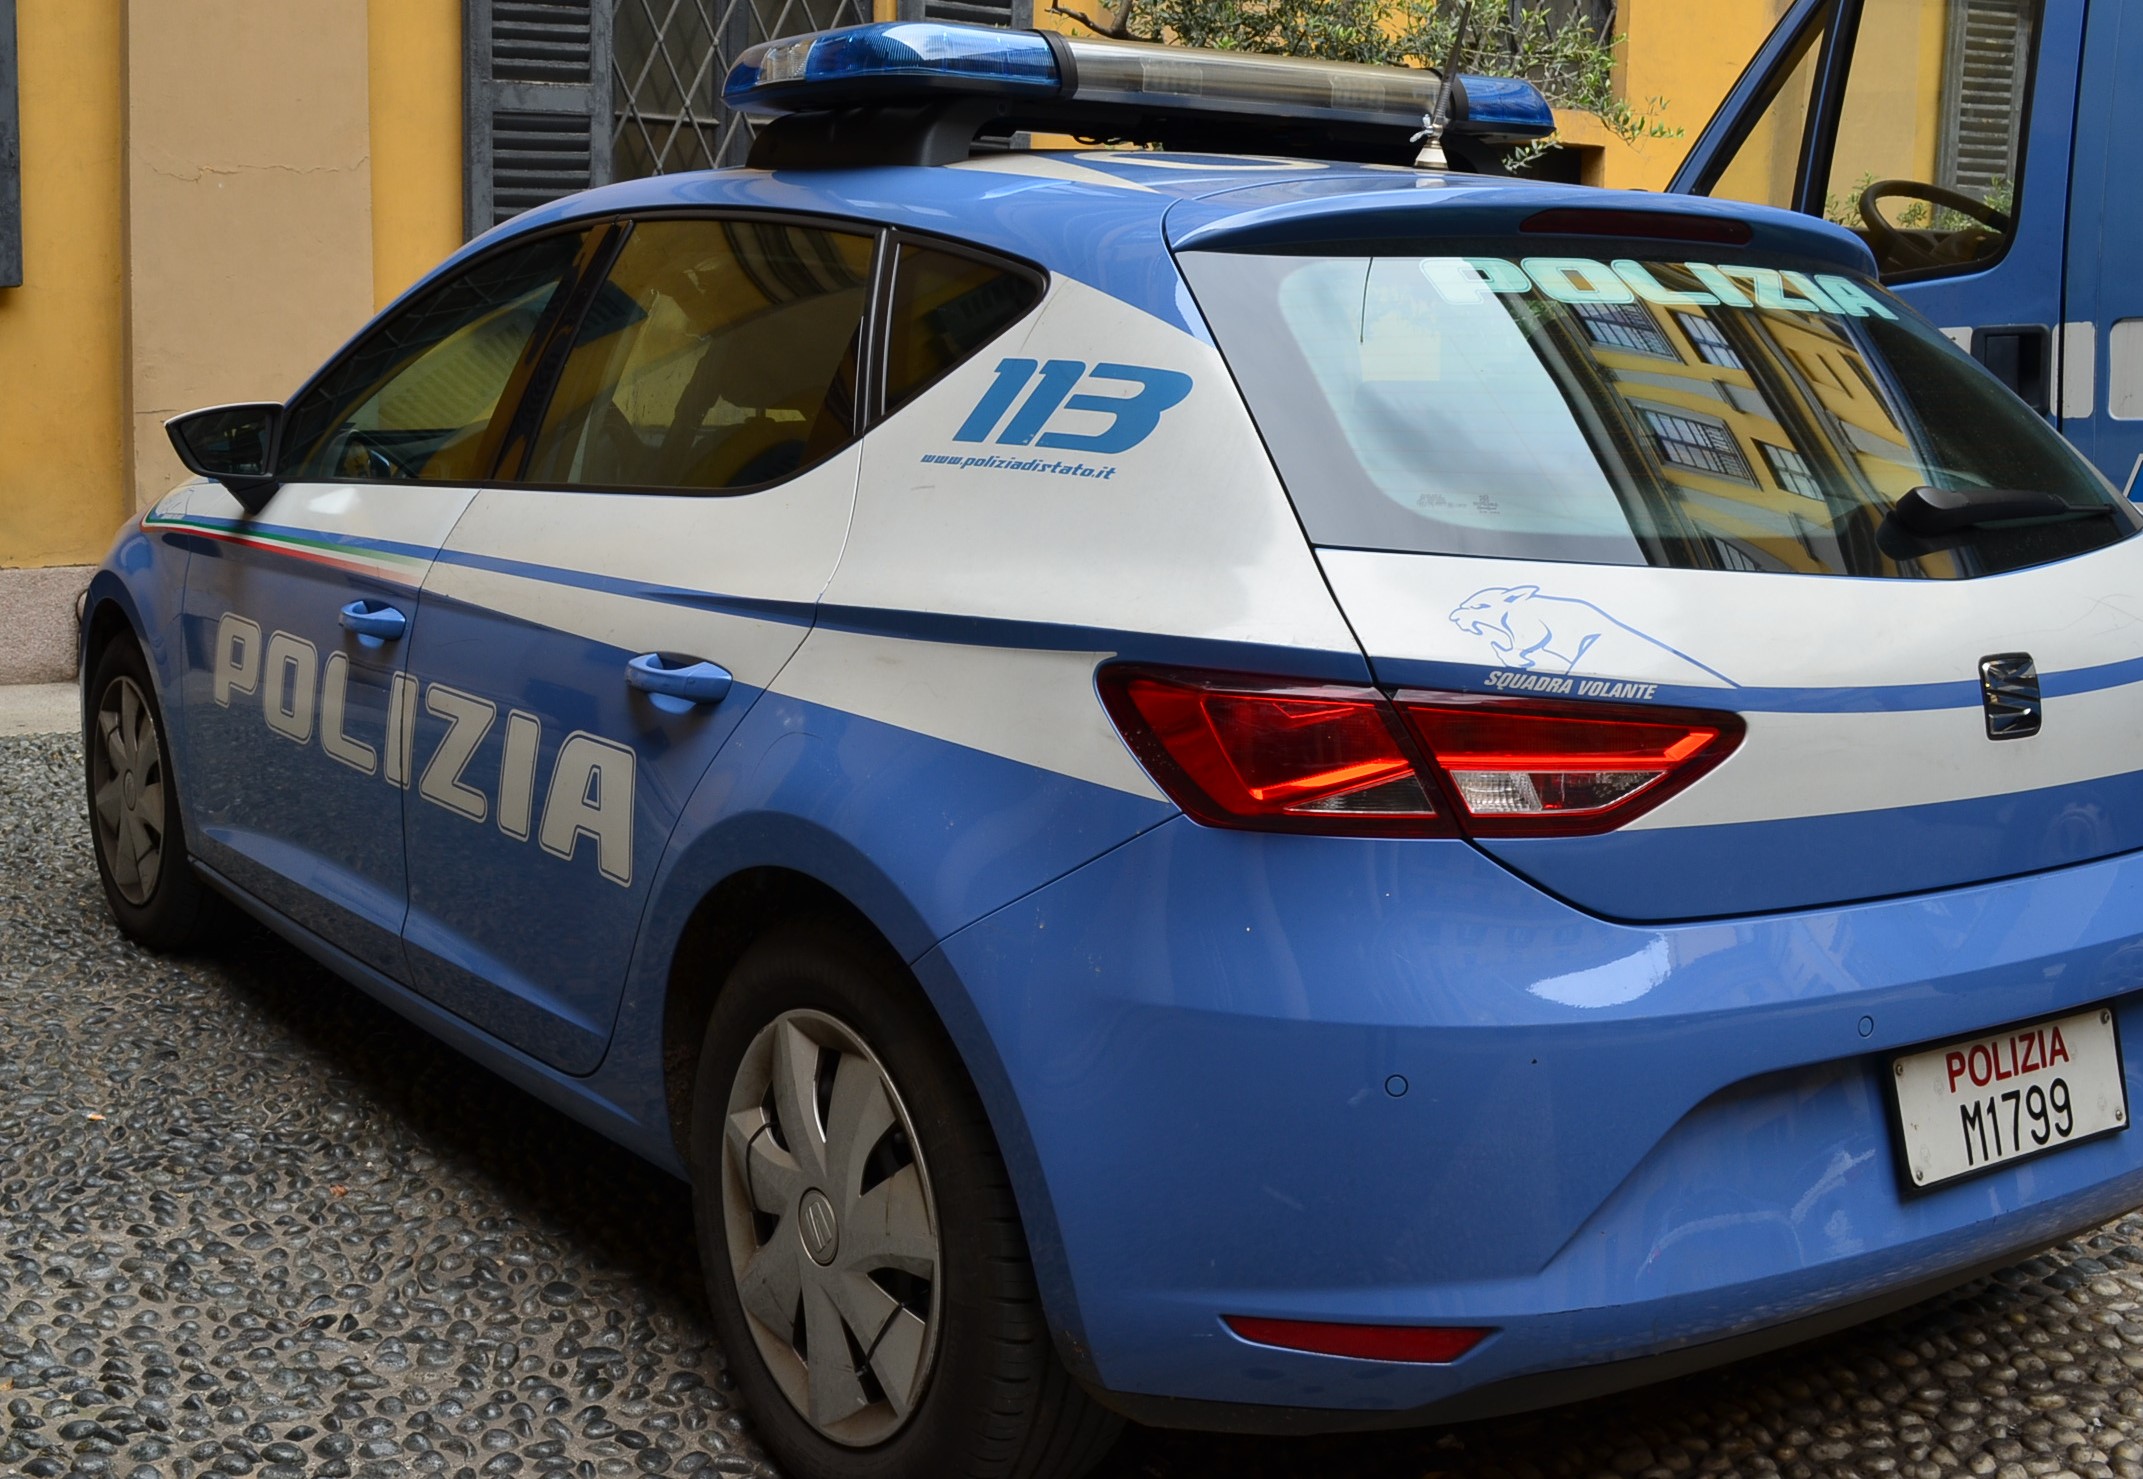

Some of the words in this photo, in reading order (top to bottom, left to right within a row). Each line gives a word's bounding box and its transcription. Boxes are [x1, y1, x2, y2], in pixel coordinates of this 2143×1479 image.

[1420, 257, 1899, 320] POLIZIA
[952, 358, 1193, 455] 113
[920, 454, 1116, 480] www.poliziadistato.it
[1484, 671, 1574, 694] SQUADRA
[1577, 680, 1658, 700] VOLANTE
[213, 611, 637, 888] POLIZIA
[1945, 1026, 2070, 1094] POLIZIA
[1959, 1077, 2074, 1167] M1799
